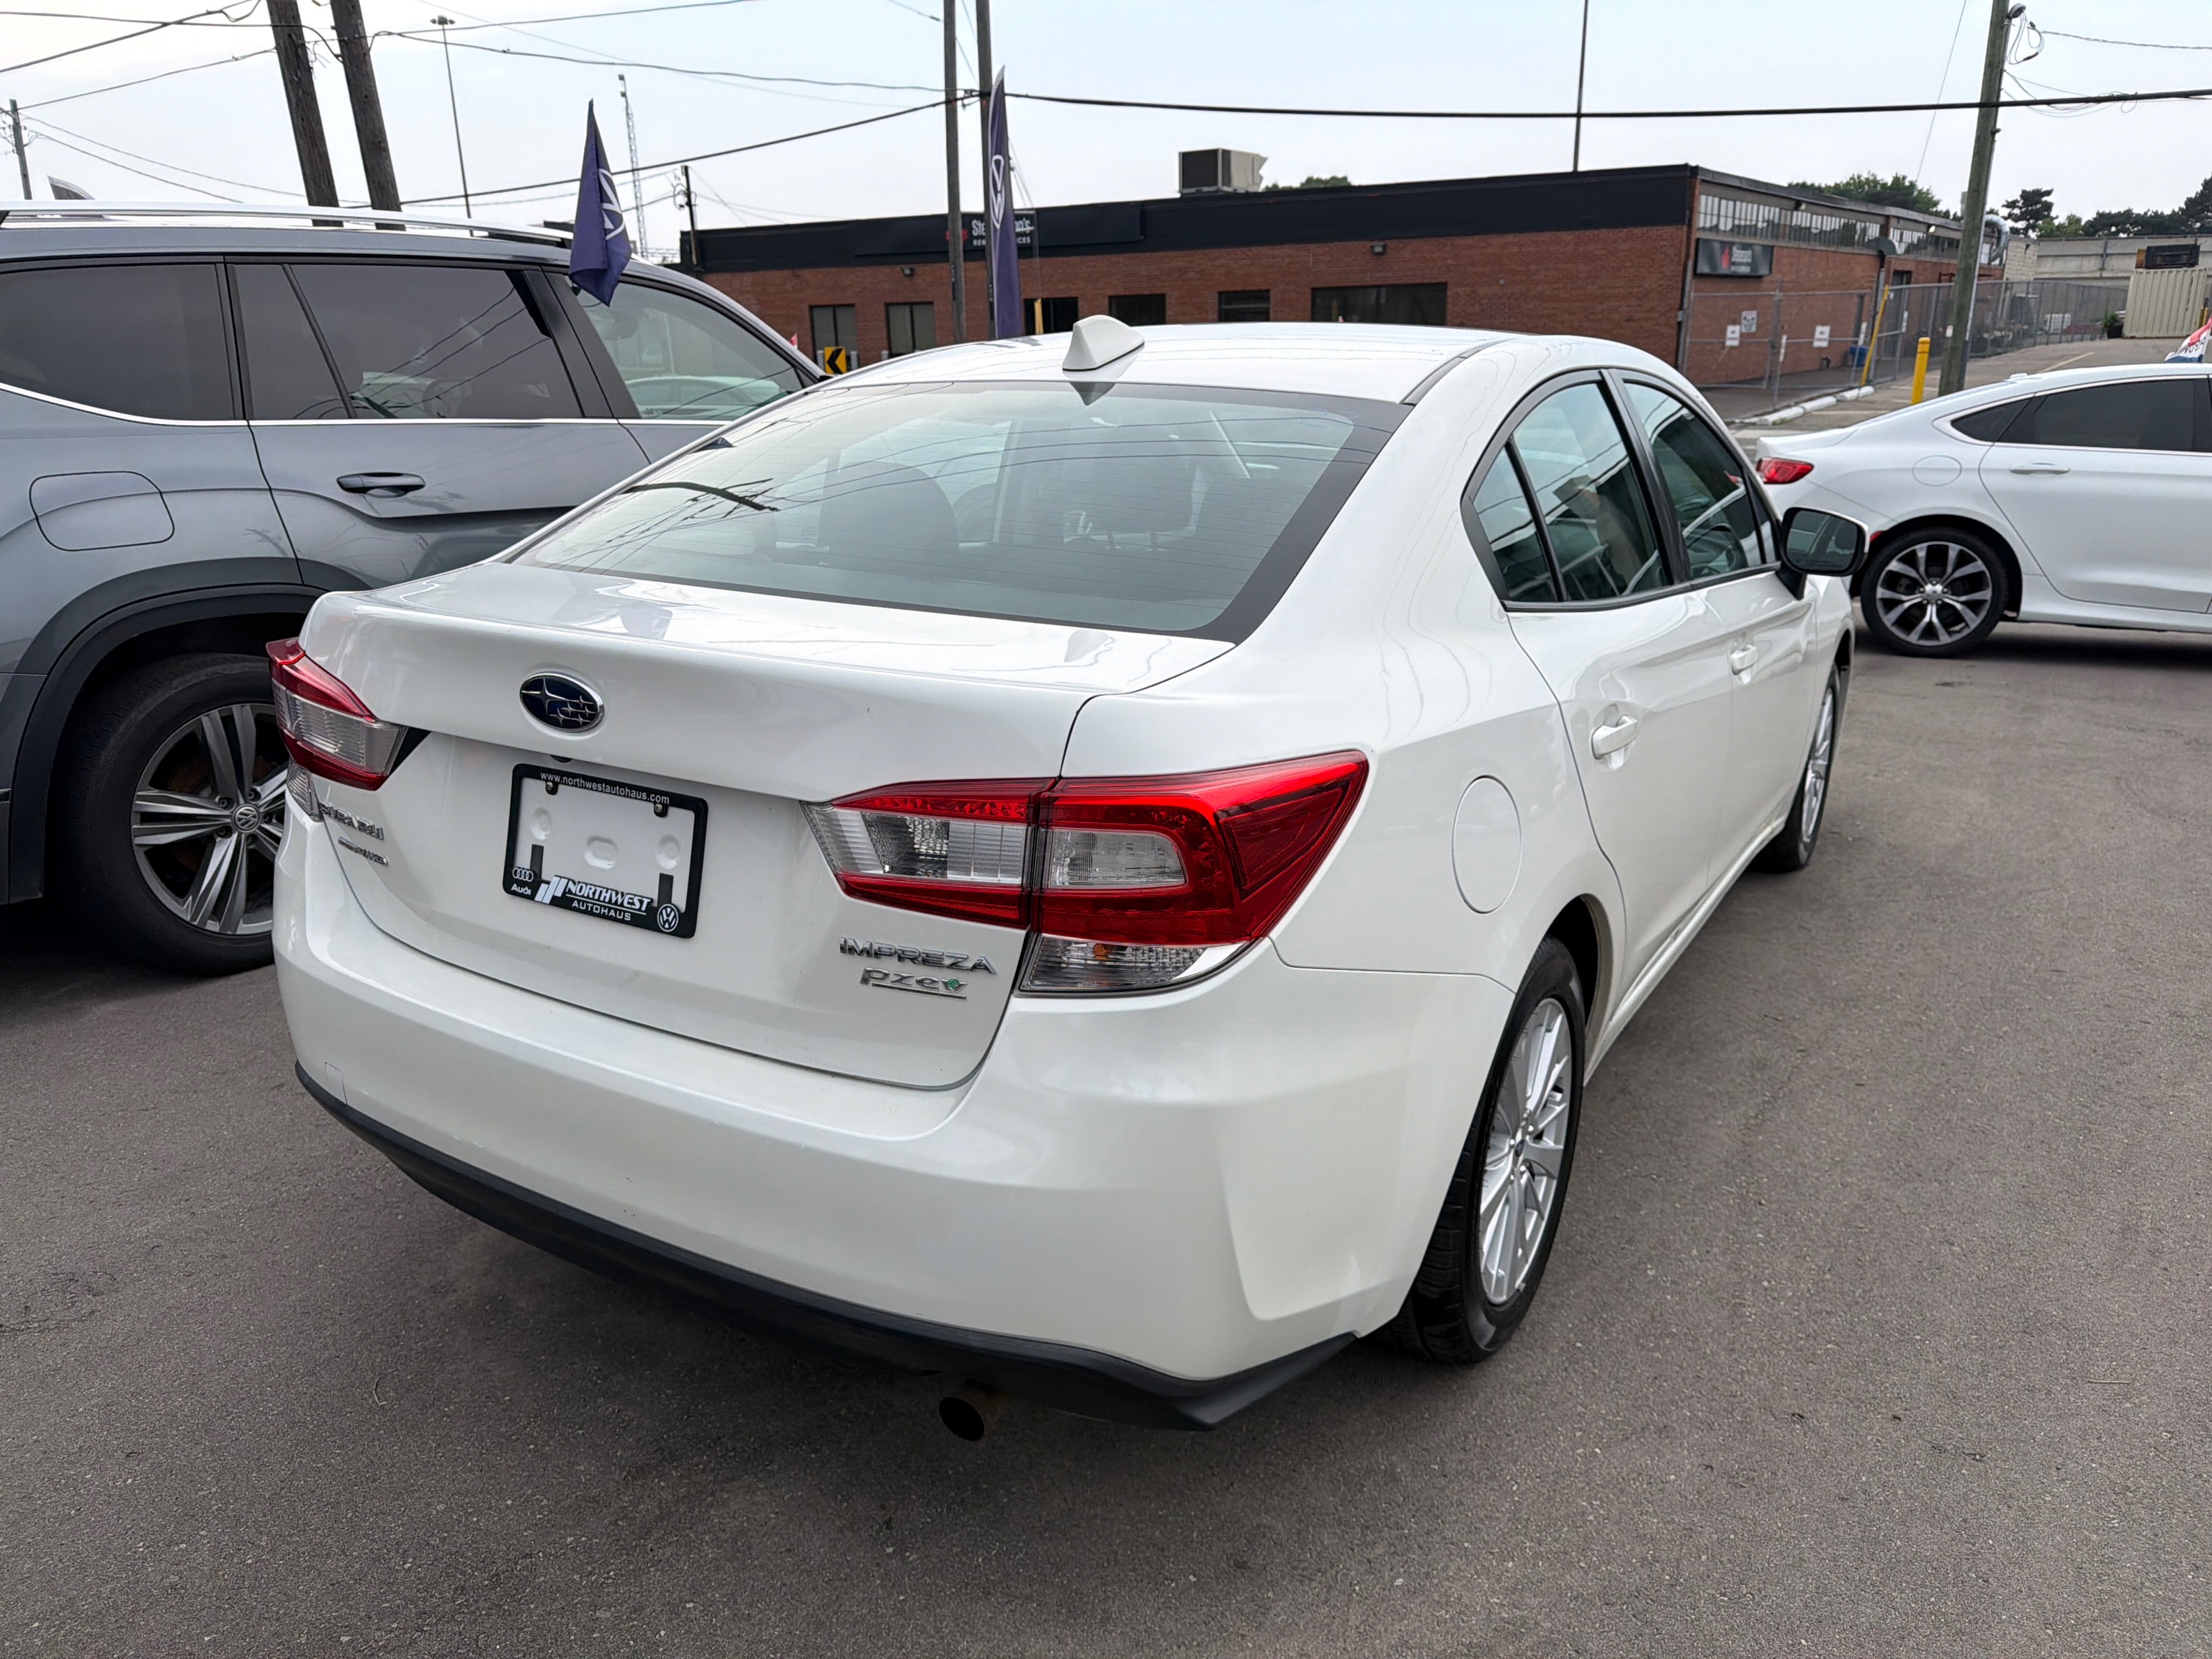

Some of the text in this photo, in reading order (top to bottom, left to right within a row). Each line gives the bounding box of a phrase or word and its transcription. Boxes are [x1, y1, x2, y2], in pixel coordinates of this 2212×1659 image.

[541, 771, 670, 805] www.northwestautohaus.com
[511, 884, 531, 896] Audi
[565, 878, 651, 912] NORTHWEST
[572, 900, 631, 922] AUTOHAUS
[839, 937, 997, 975] IMPREZA
